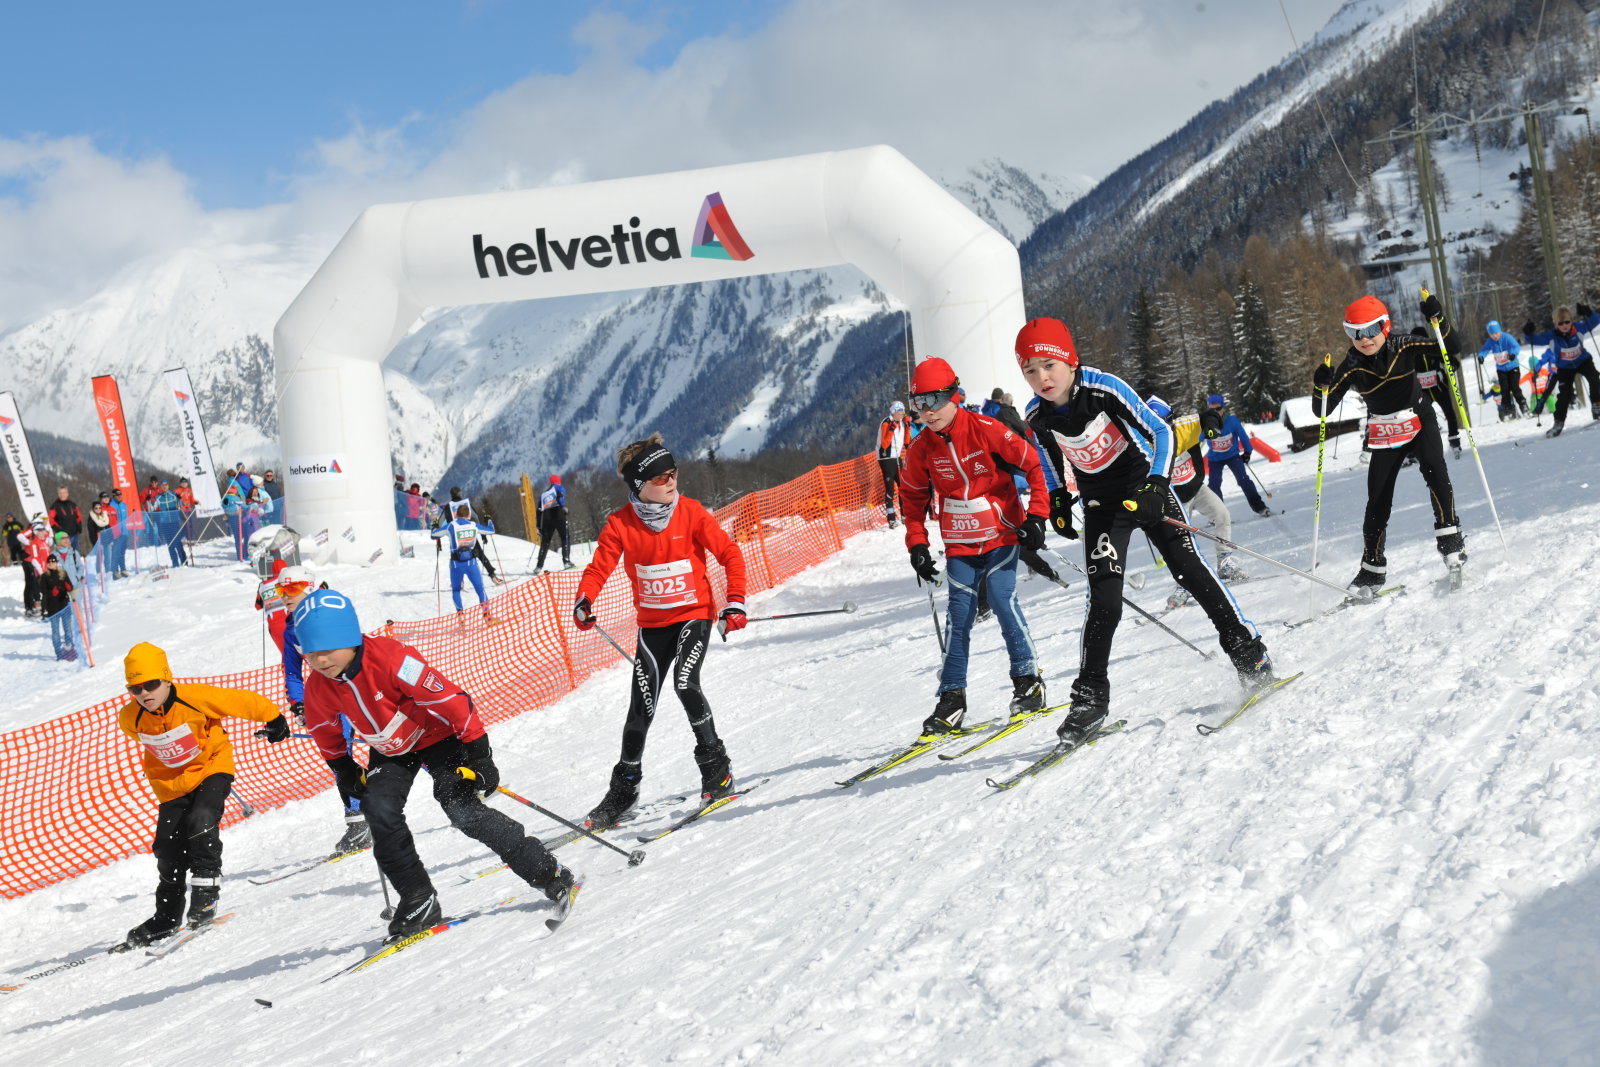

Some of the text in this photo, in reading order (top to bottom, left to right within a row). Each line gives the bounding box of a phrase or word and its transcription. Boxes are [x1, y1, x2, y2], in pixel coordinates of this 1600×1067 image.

[472, 216, 682, 279] helvetia
[1065, 432, 1113, 463] 3030
[290, 464, 327, 475] helvetia
[460, 530, 474, 538] 288
[951, 519, 980, 530] 3019
[642, 576, 686, 595] 3025
[678, 640, 704, 690] RAIFFEISEN
[634, 658, 655, 717] swisscom
[155, 744, 185, 759] 3015
[406, 898, 432, 920] SALOMON
[395, 931, 430, 952] SALOMON
[24, 959, 86, 981] ROSSIGNOL
